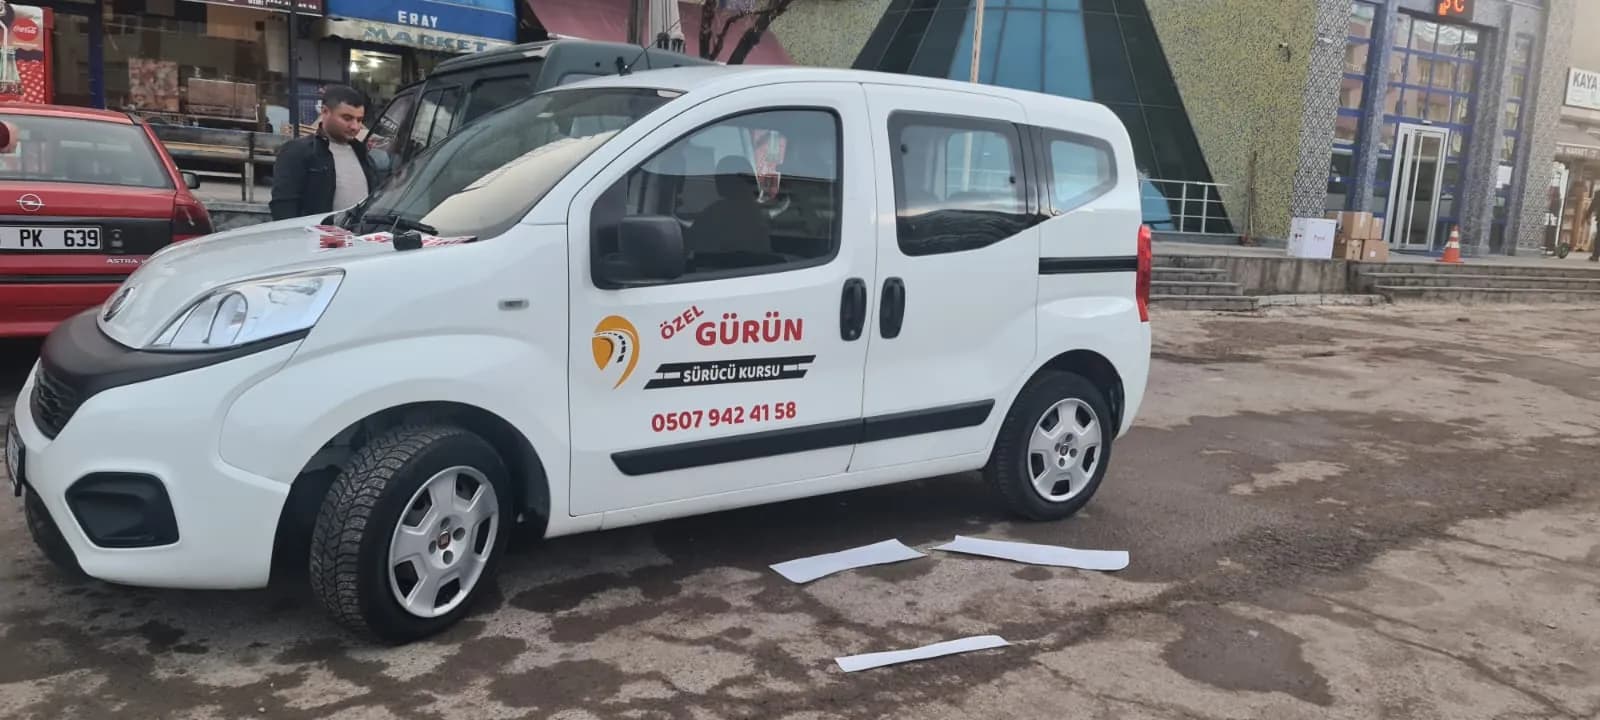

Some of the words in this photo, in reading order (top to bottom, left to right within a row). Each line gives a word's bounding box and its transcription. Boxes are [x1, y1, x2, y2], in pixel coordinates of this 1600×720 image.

[397, 10, 438, 28] ERAY
[364, 26, 488, 52] MARKET
[1573, 71, 1598, 90] KAYA
[19, 229, 43, 248] PK
[63, 229, 99, 248] 639
[659, 304, 705, 340] ÖZEL
[695, 311, 803, 346] GÜRÜN
[683, 364, 736, 383] SÜRÜCÜ
[738, 364, 781, 379] KURSU
[651, 410, 704, 432] 0507
[708, 406, 745, 426] 942
[749, 404, 769, 421] 41
[774, 401, 797, 420] 58
